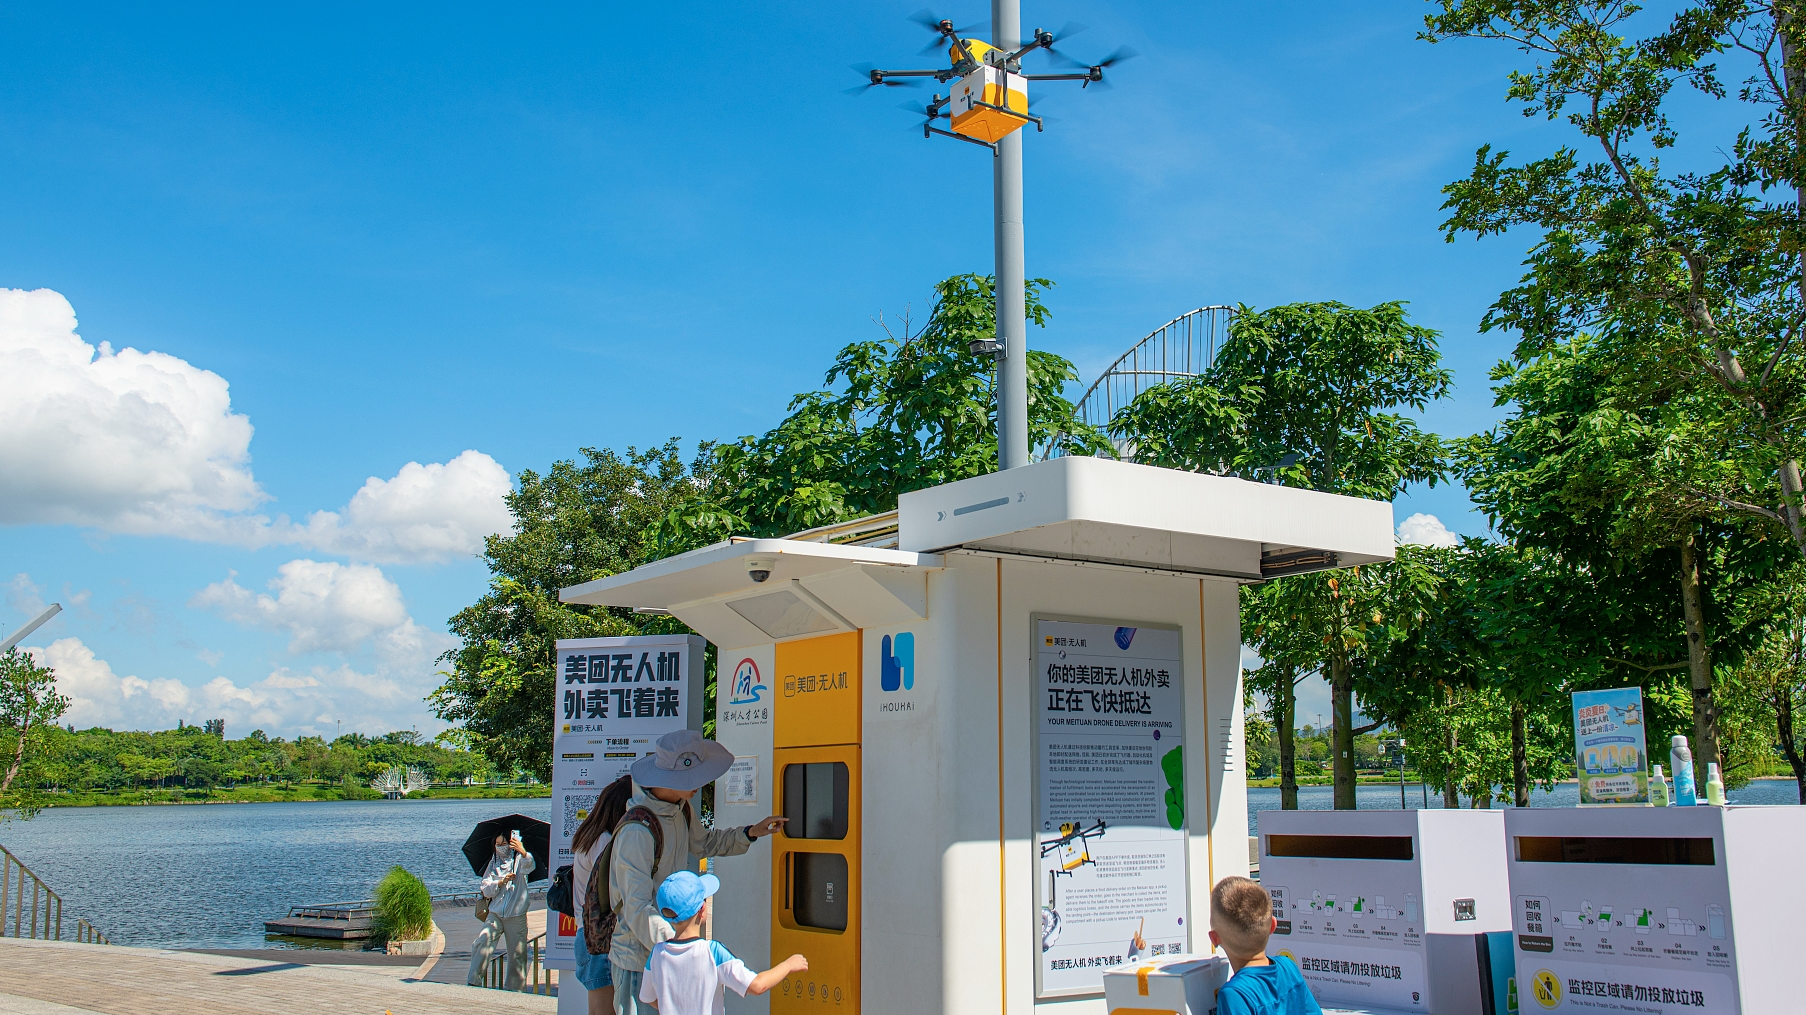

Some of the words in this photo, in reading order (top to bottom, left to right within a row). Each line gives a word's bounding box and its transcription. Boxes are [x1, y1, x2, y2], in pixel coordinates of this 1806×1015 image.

[564, 651, 680, 684] 美团无人机
[1047, 664, 1170, 688] 你的美团无人机外卖
[564, 686, 680, 720] 外卖飞着来
[1048, 688, 1152, 715] 正在飞快抵达
[1581, 715, 1609, 728] 美团无人机
[1525, 900, 1540, 910] 如何
[1526, 912, 1542, 921] 回收
[1527, 923, 1542, 933] 餐箱
[1051, 958, 1086, 970] 美团无人机
[1088, 955, 1122, 967] 外卖飞着来
[1302, 957, 1402, 980] 监控区域请勿投放垃圾
[1568, 978, 1705, 1007] 监控区域请勿投放垃圾
